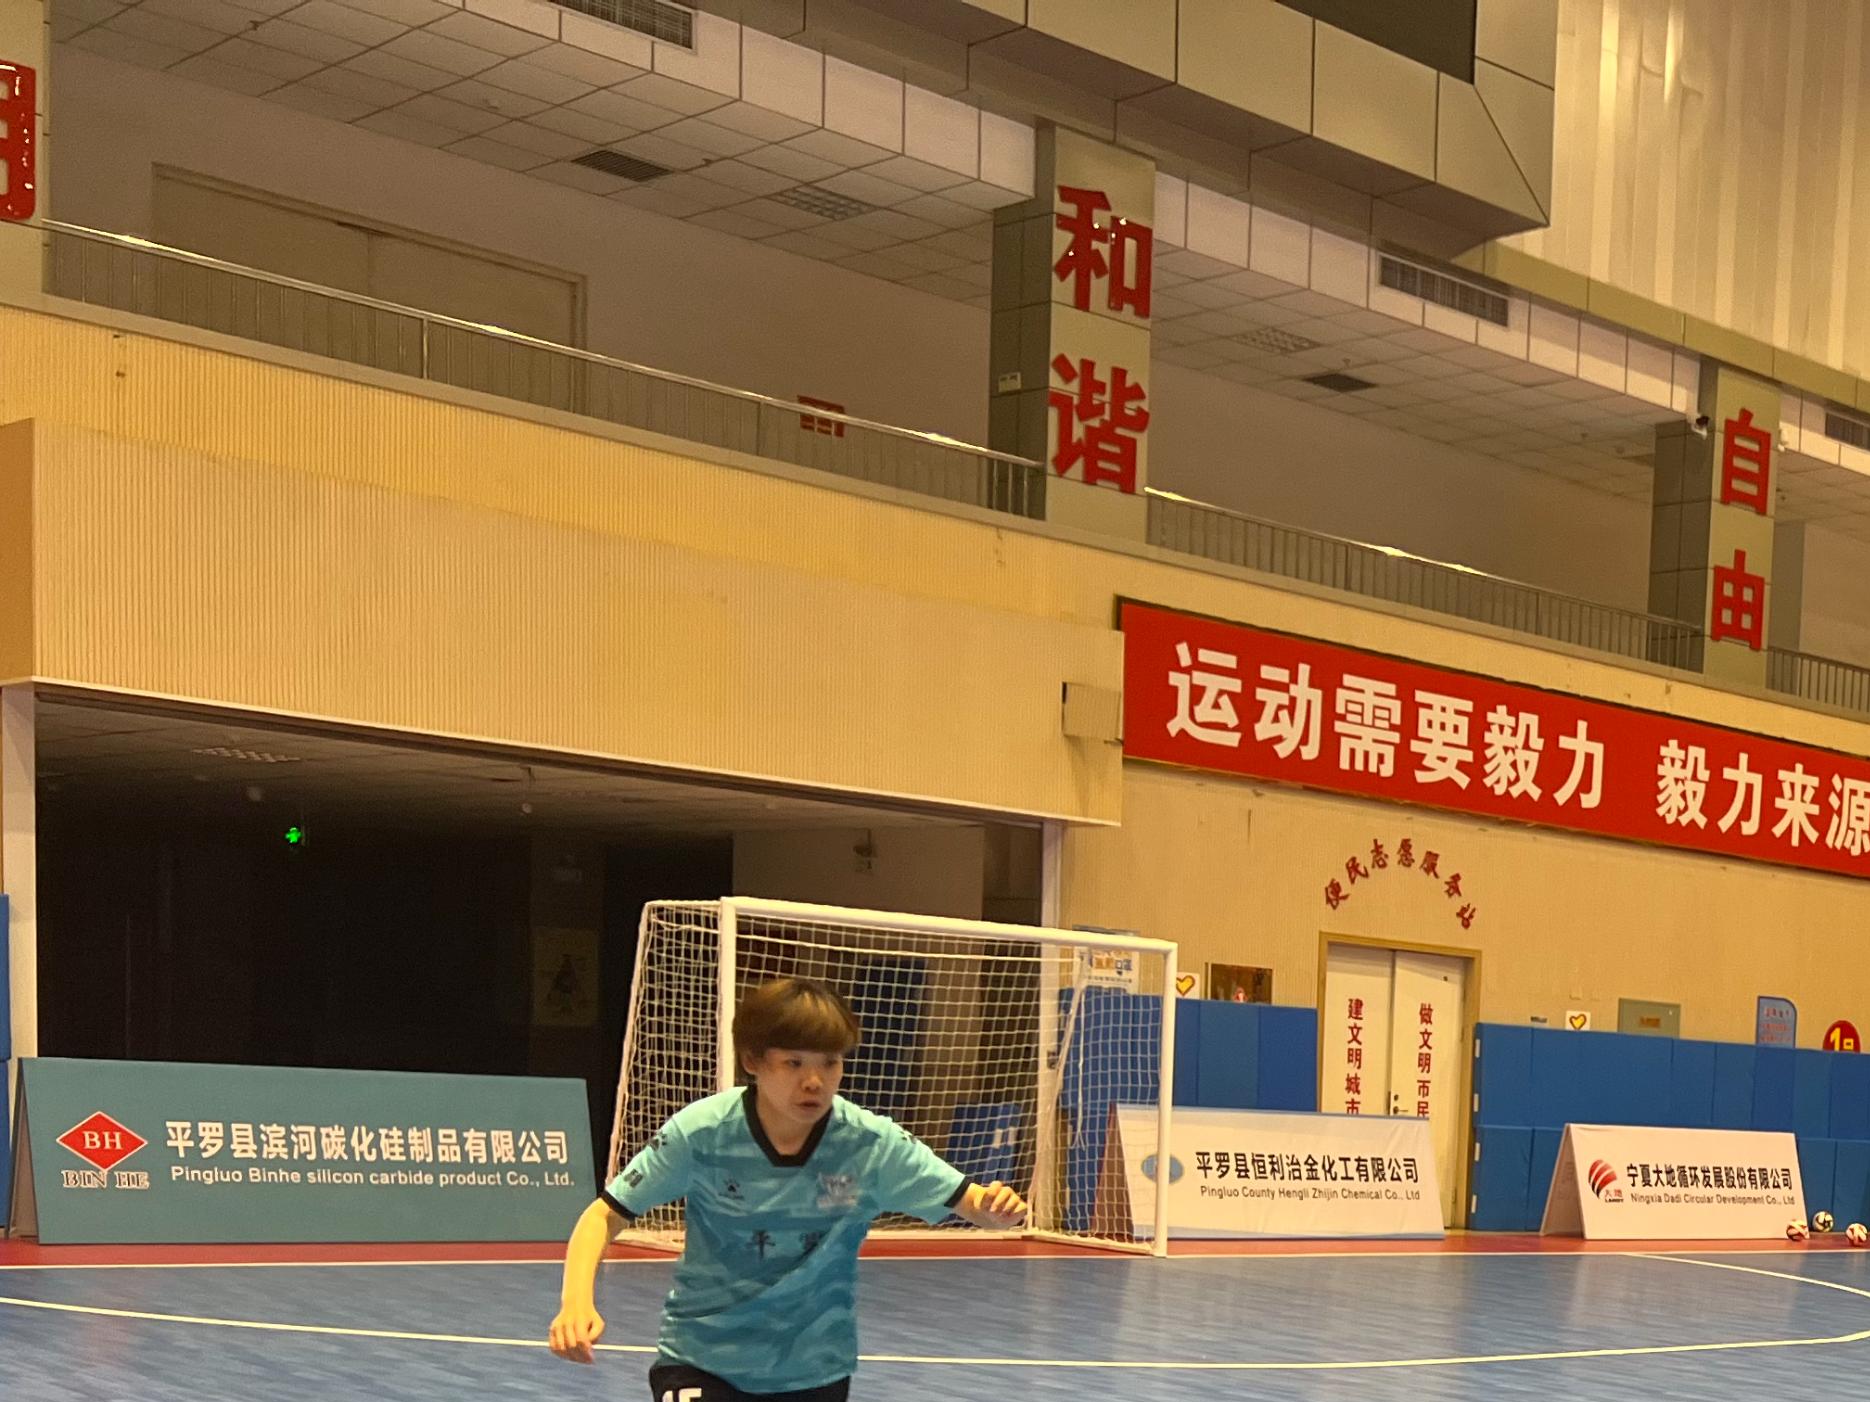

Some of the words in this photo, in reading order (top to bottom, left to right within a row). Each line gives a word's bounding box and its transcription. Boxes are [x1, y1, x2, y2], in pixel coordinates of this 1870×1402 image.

[1047, 184, 1153, 495] 和谐
[1711, 407, 1772, 652] 自由
[1166, 641, 1605, 810] 运动需要毅力
[1344, 997, 1364, 1115] 建文明城市
[82, 1130, 124, 1150] BH
[165, 1120, 569, 1165] 平罗县滨河碳化硅制品有限公司
[60, 1168, 108, 1189] BIN
[114, 1170, 150, 1190] HE
[170, 1165, 243, 1185] Pingluo
[249, 1167, 301, 1184] Binhe
[306, 1168, 364, 1185] silicon
[369, 1169, 435, 1186] carbide
[438, 1170, 502, 1188] product
[544, 1171, 575, 1187] Ltd.
[1200, 1185, 1240, 1201] Pingluo
[1241, 1186, 1276, 1201] County
[1341, 1188, 1383, 1201] Chemical
[1630, 1193, 1663, 1206] Ningxia
[1663, 1193, 1683, 1204] Dadi
